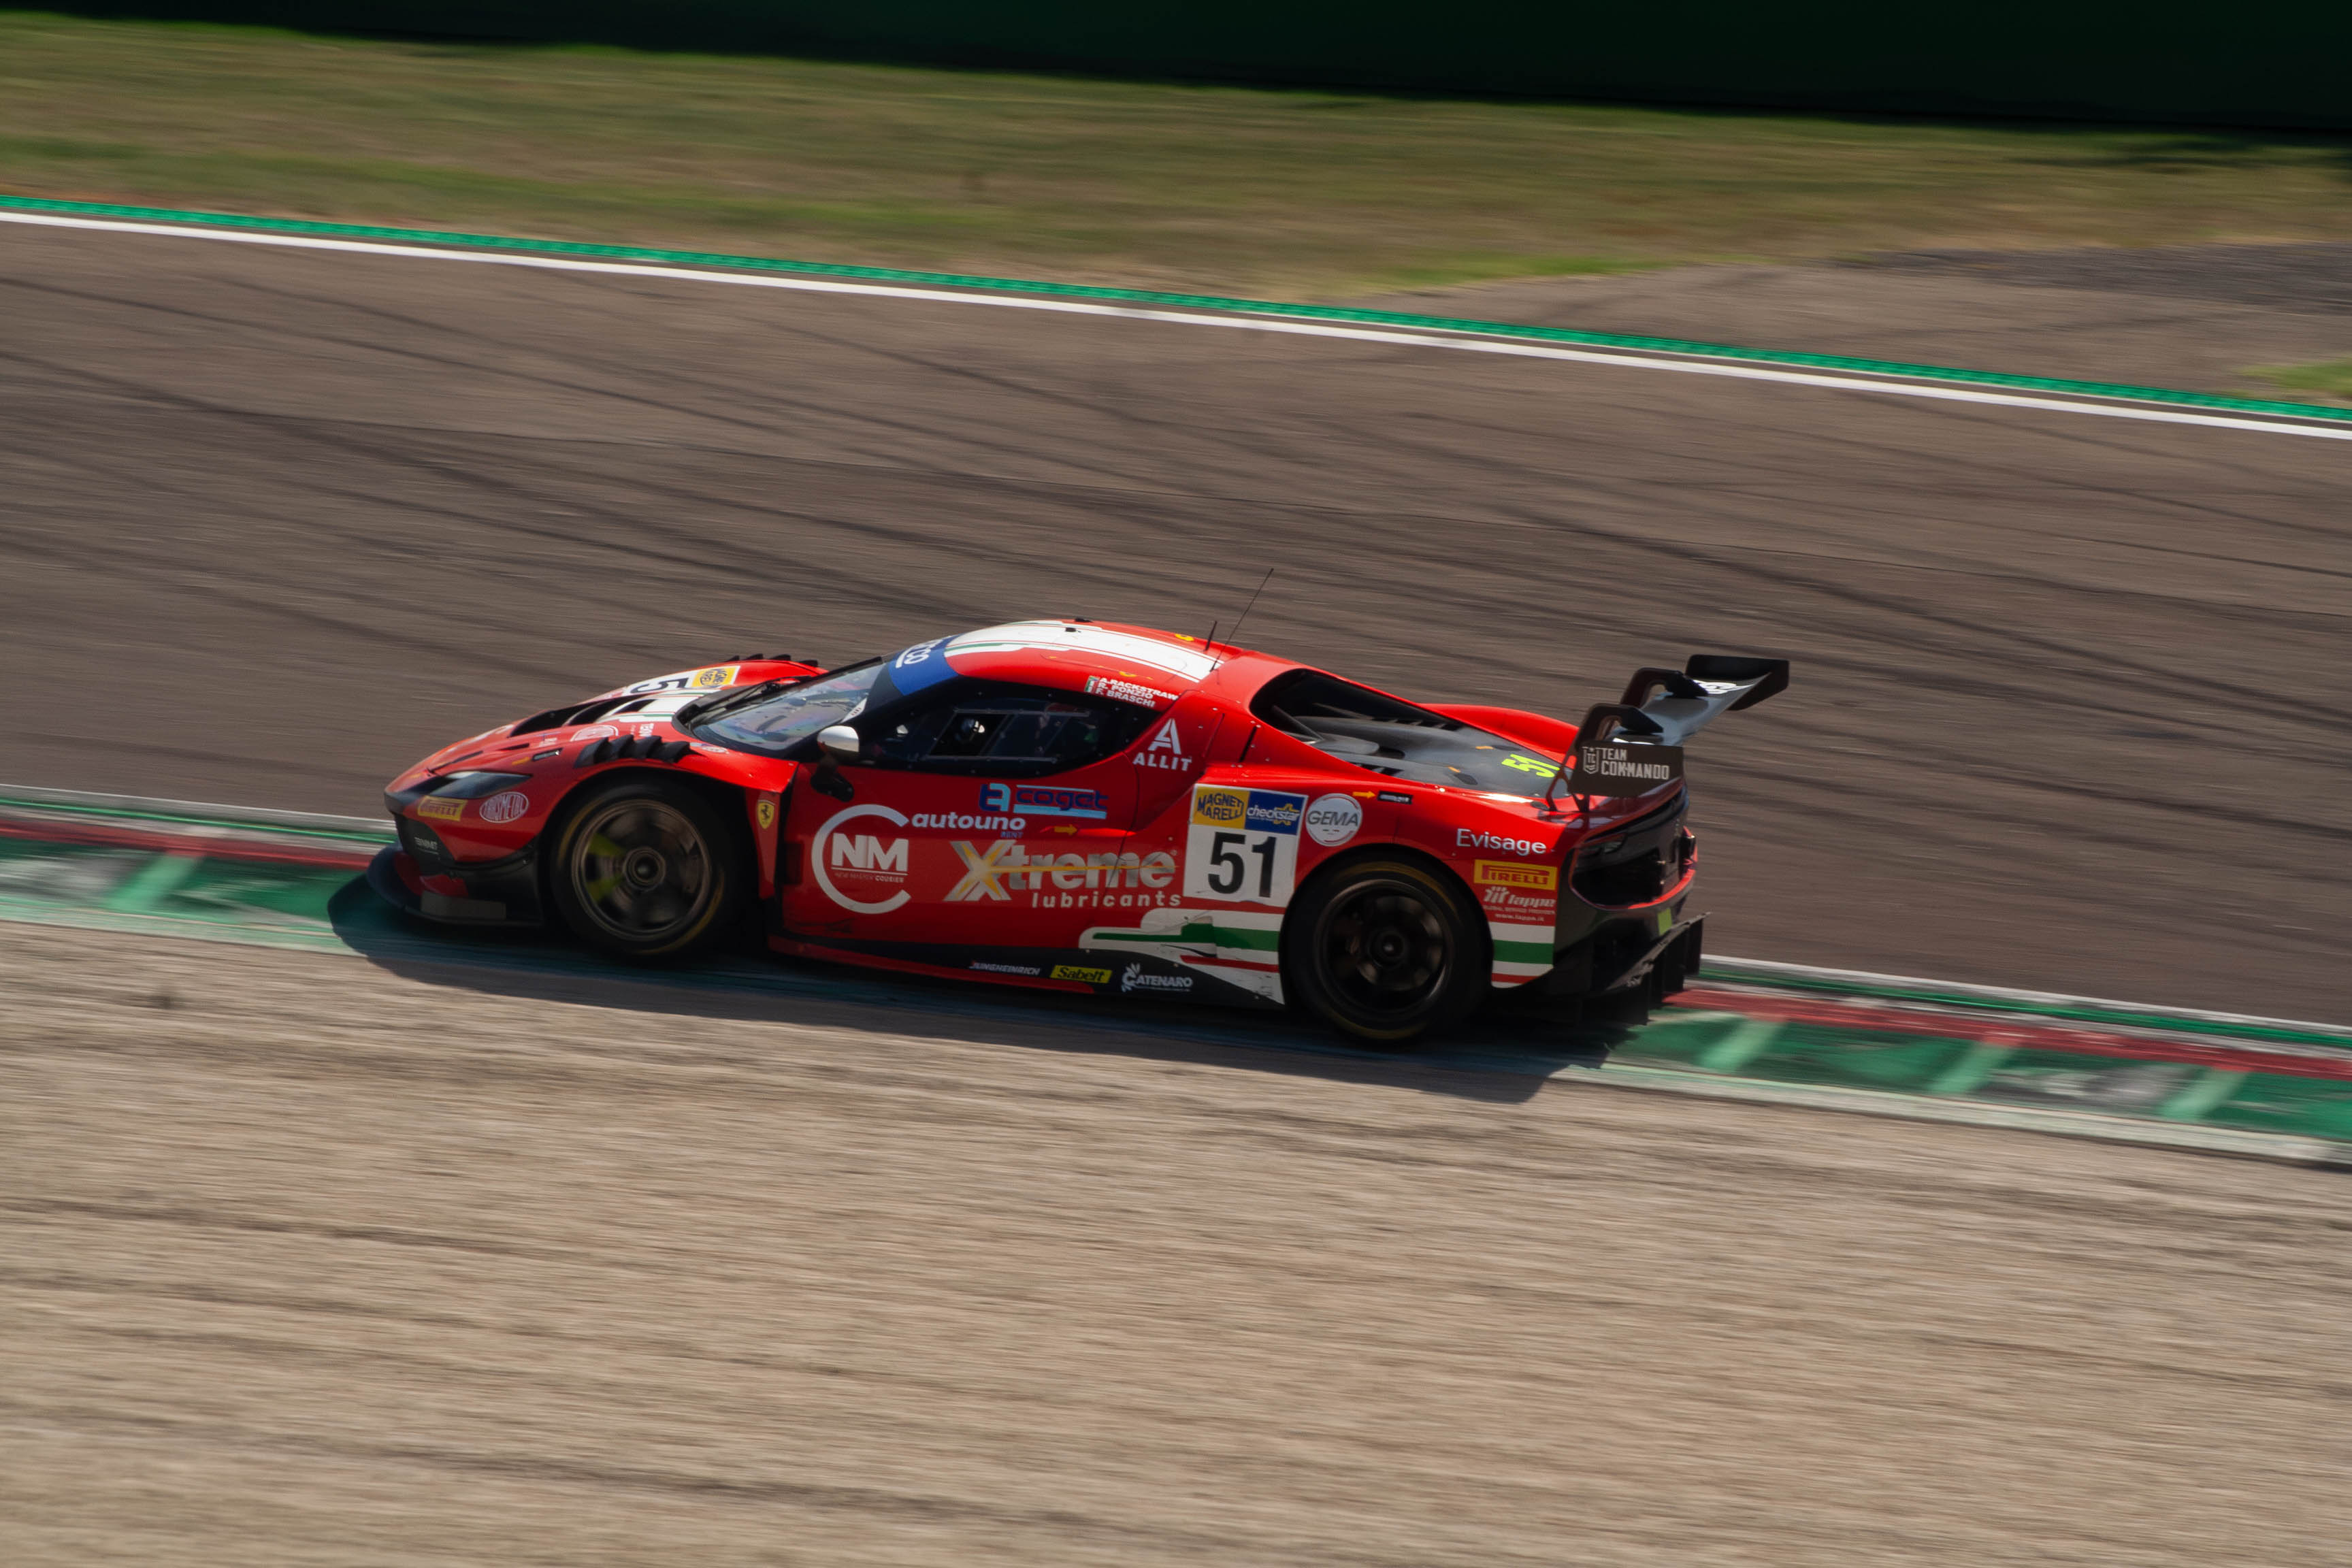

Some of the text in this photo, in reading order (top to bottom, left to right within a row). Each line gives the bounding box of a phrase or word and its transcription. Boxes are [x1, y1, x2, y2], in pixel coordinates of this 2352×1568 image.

[1107, 690, 1156, 708] BRASCHI
[1111, 685, 1154, 700] PONZIO
[1132, 752, 1192, 772] ALLIT
[1601, 748, 1627, 761] TEAM
[1501, 753, 1561, 778] 51
[1601, 760, 1670, 780] COMMANDO
[1016, 790, 1109, 812] coget
[1197, 793, 1245, 812] MAGNETI
[912, 812, 1026, 830] autouno
[1197, 804, 1245, 821] MARELLI
[1247, 804, 1302, 822] checkstar
[1307, 810, 1360, 828] GEMA
[1456, 828, 1547, 856] Evisage
[943, 839, 1176, 902] Xtreme
[1207, 831, 1277, 898] 51
[1482, 865, 1550, 885] PIRELLI
[1032, 892, 1181, 909] lubricants
[969, 961, 1041, 975] JUNGHEINRICH
[1057, 966, 1105, 981] Sabelt
[1122, 970, 1193, 987] CATENARO
